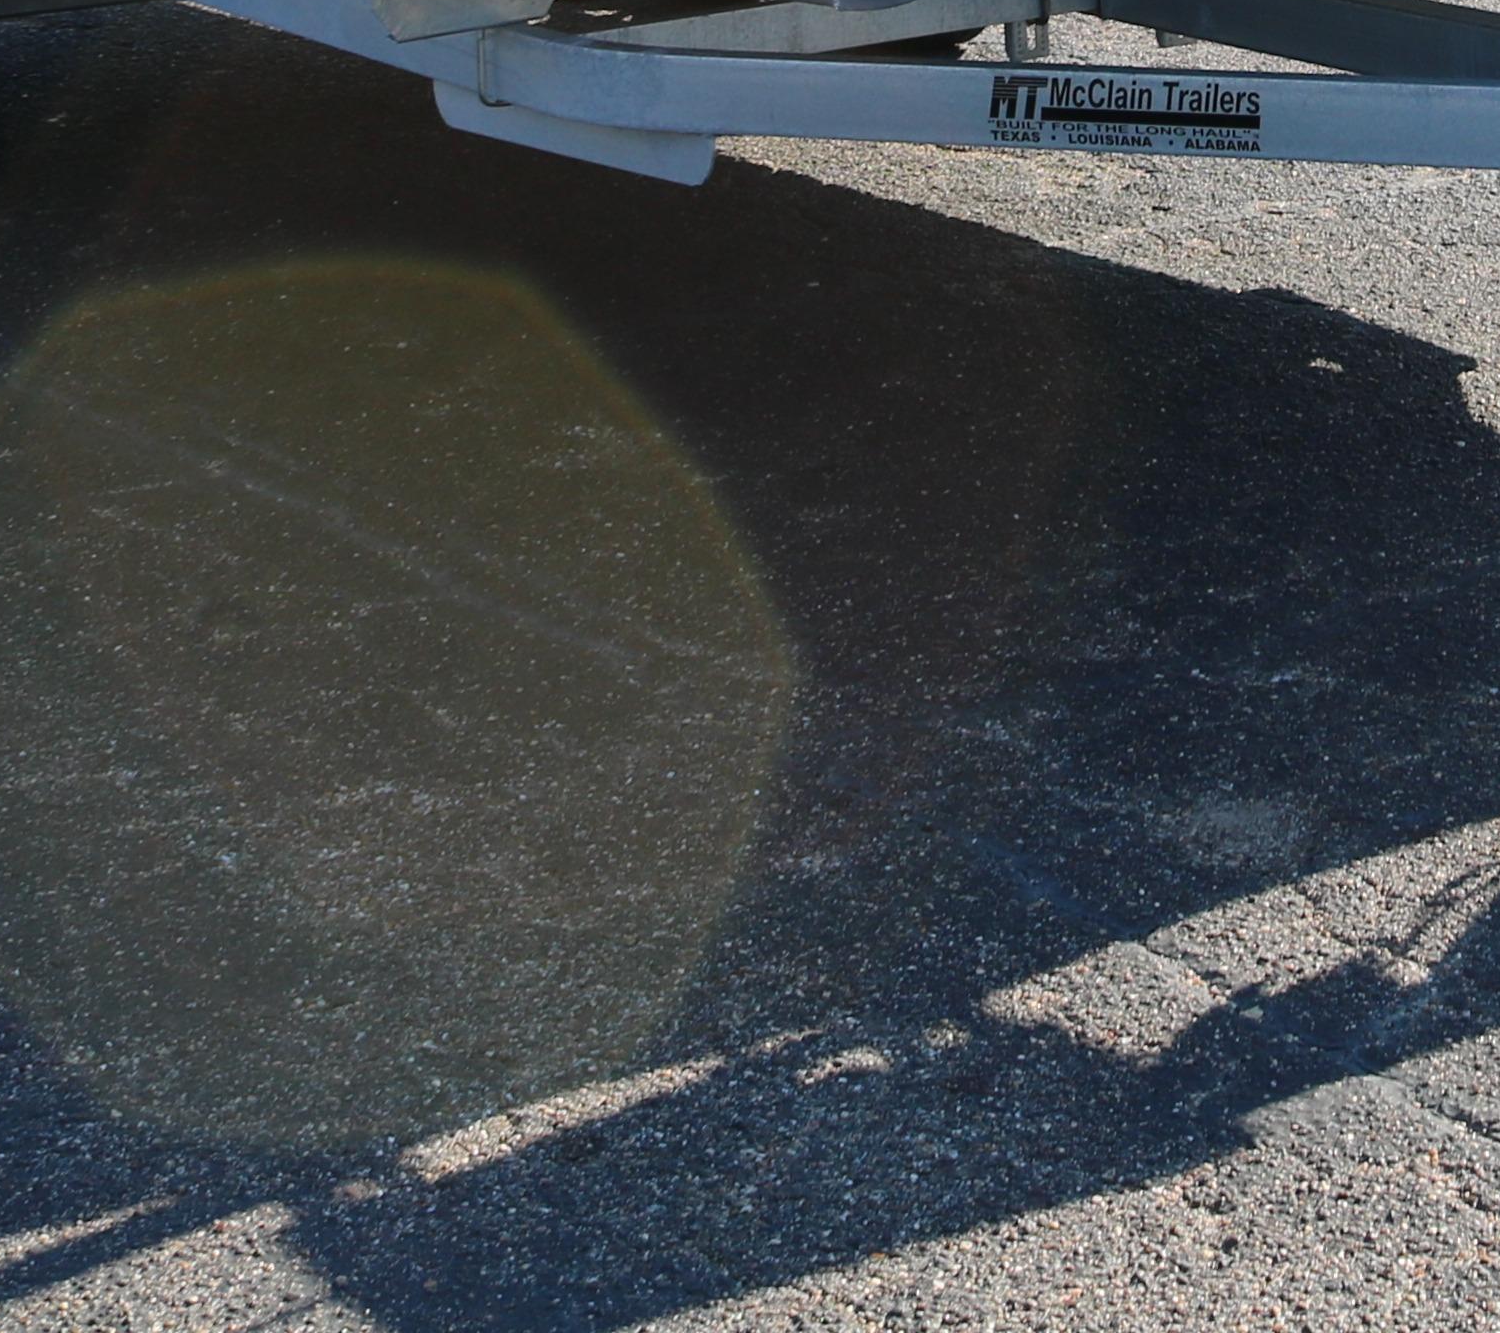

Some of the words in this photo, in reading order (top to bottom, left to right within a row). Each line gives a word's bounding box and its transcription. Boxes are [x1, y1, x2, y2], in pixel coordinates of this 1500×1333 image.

[1050, 77, 1152, 110] McClain
[1162, 81, 1261, 114] Trailers
[990, 129, 1041, 144] TEXAS
[1068, 134, 1152, 148] LOUISIANA
[1184, 138, 1261, 152] ALABAMA
[1051, 121, 1088, 132] FOR
[1094, 123, 1128, 134] THE
[1135, 125, 1187, 137] LONG
